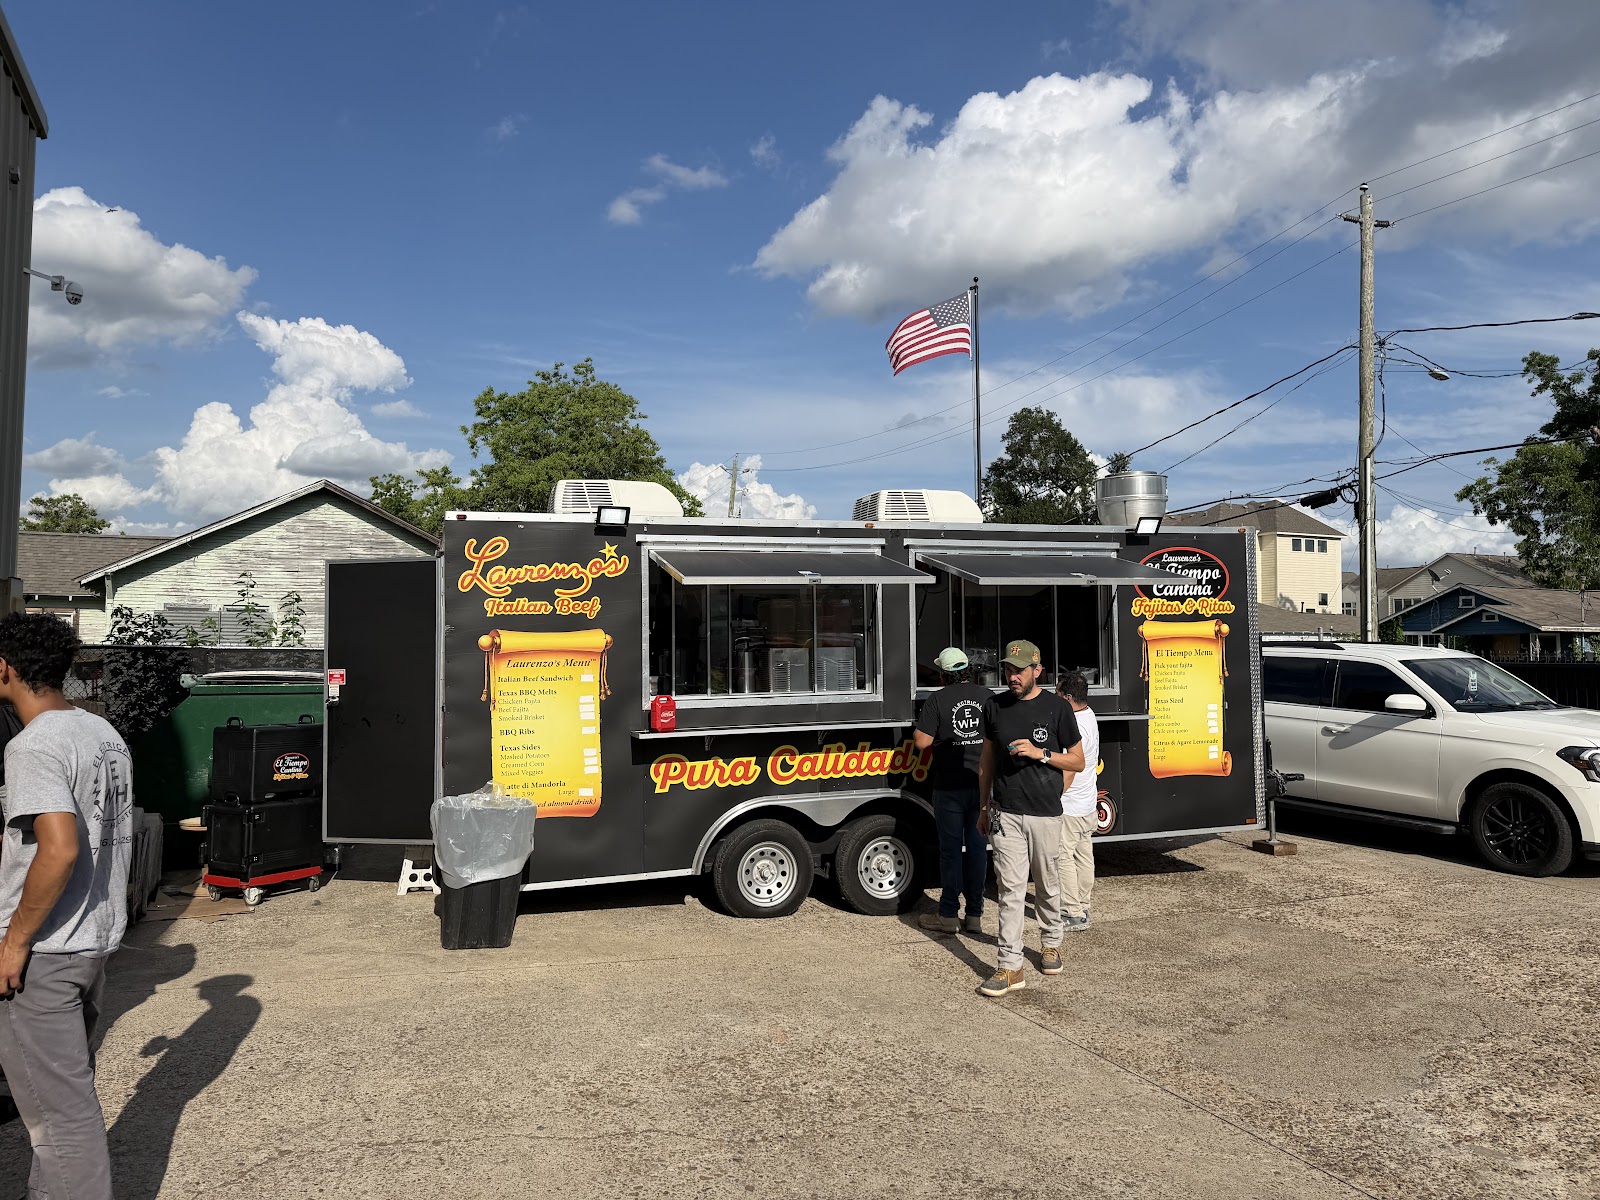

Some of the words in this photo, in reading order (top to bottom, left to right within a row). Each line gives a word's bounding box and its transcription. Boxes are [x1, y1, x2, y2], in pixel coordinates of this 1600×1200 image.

[1162, 553, 1202, 563] Laurenzo's
[484, 597, 553, 617] Italian
[555, 596, 602, 619] Beef
[1131, 597, 1182, 620] Fajitas
[1184, 598, 1196, 614] &
[1196, 597, 1236, 618] Ritas
[1156, 649, 1164, 657] El
[1165, 649, 1193, 659] Tiempo
[506, 659, 561, 669] Laurenzo's
[540, 674, 574, 682] Sandwich
[519, 689, 537, 697] BBQ
[538, 688, 557, 696] Melts
[524, 698, 541, 706] Fajita
[512, 706, 530, 714] Fajita
[964, 708, 972, 718] E
[498, 714, 523, 722] Smoked
[957, 718, 980, 729] WH
[519, 728, 535, 736] Ribs
[500, 744, 520, 752] Texas
[526, 752, 550, 760] Potatoes
[275, 760, 284, 768] El
[284, 759, 308, 768] Tiempo
[650, 754, 761, 793] Pura
[767, 740, 933, 785] Calidad!
[280, 766, 303, 774] Cantina
[521, 769, 544, 777] Veggies
[547, 800, 574, 808] almond
[574, 798, 597, 806] drink)
